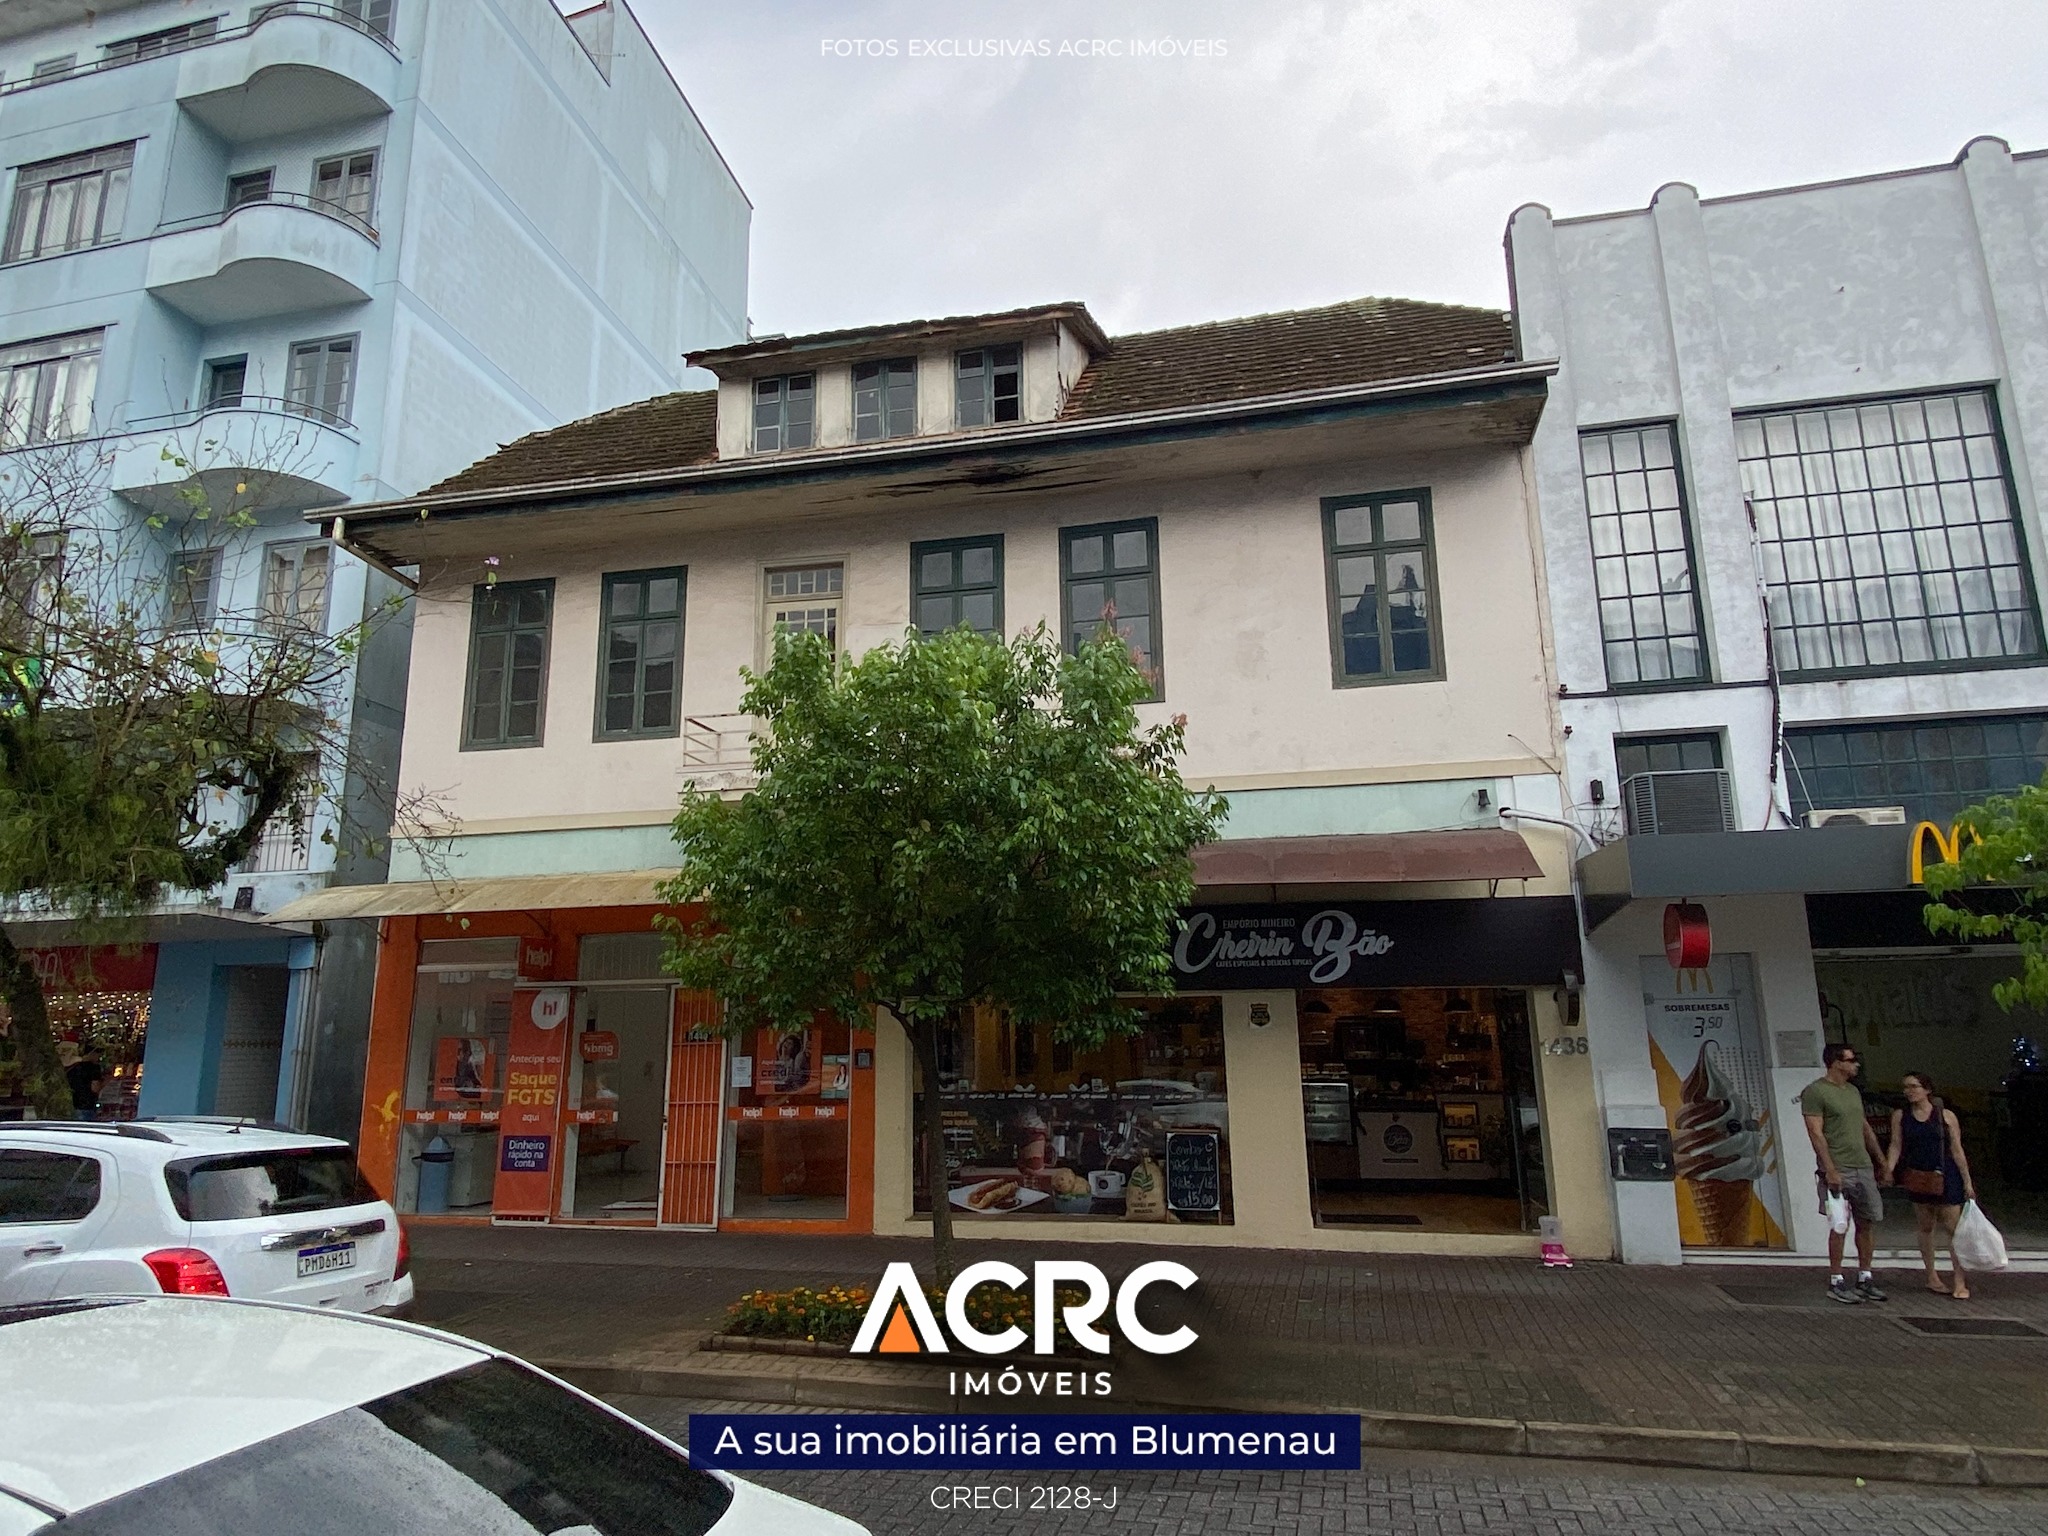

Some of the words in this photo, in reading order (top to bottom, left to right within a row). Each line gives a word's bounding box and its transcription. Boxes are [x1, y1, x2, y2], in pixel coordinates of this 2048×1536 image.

[1261, 917, 1295, 928] MINEIRO
[1174, 912, 1295, 974] Cheirin
[1301, 909, 1395, 984] Bão
[525, 945, 553, 970] help!
[1664, 1003, 1730, 1012] SOBREMESAS
[1693, 1016, 1723, 1038] 3,50
[591, 1042, 614, 1056] bmg
[1541, 1036, 1588, 1056] 1436
[509, 1054, 545, 1065] Antecipe
[546, 1055, 562, 1064] seu
[509, 1072, 557, 1088] Saque
[506, 1088, 556, 1105] FGTS
[416, 1111, 435, 1121] help!
[448, 1111, 467, 1121] help!
[480, 1110, 499, 1121] help!
[521, 1113, 540, 1123] aqui
[576, 1110, 596, 1121] help!
[743, 1107, 762, 1118] help!
[779, 1106, 799, 1118] help!
[815, 1106, 835, 1118] help!
[508, 1139, 545, 1151] Dinheiro
[507, 1149, 532, 1161] rápido
[514, 1160, 535, 1168] conta
